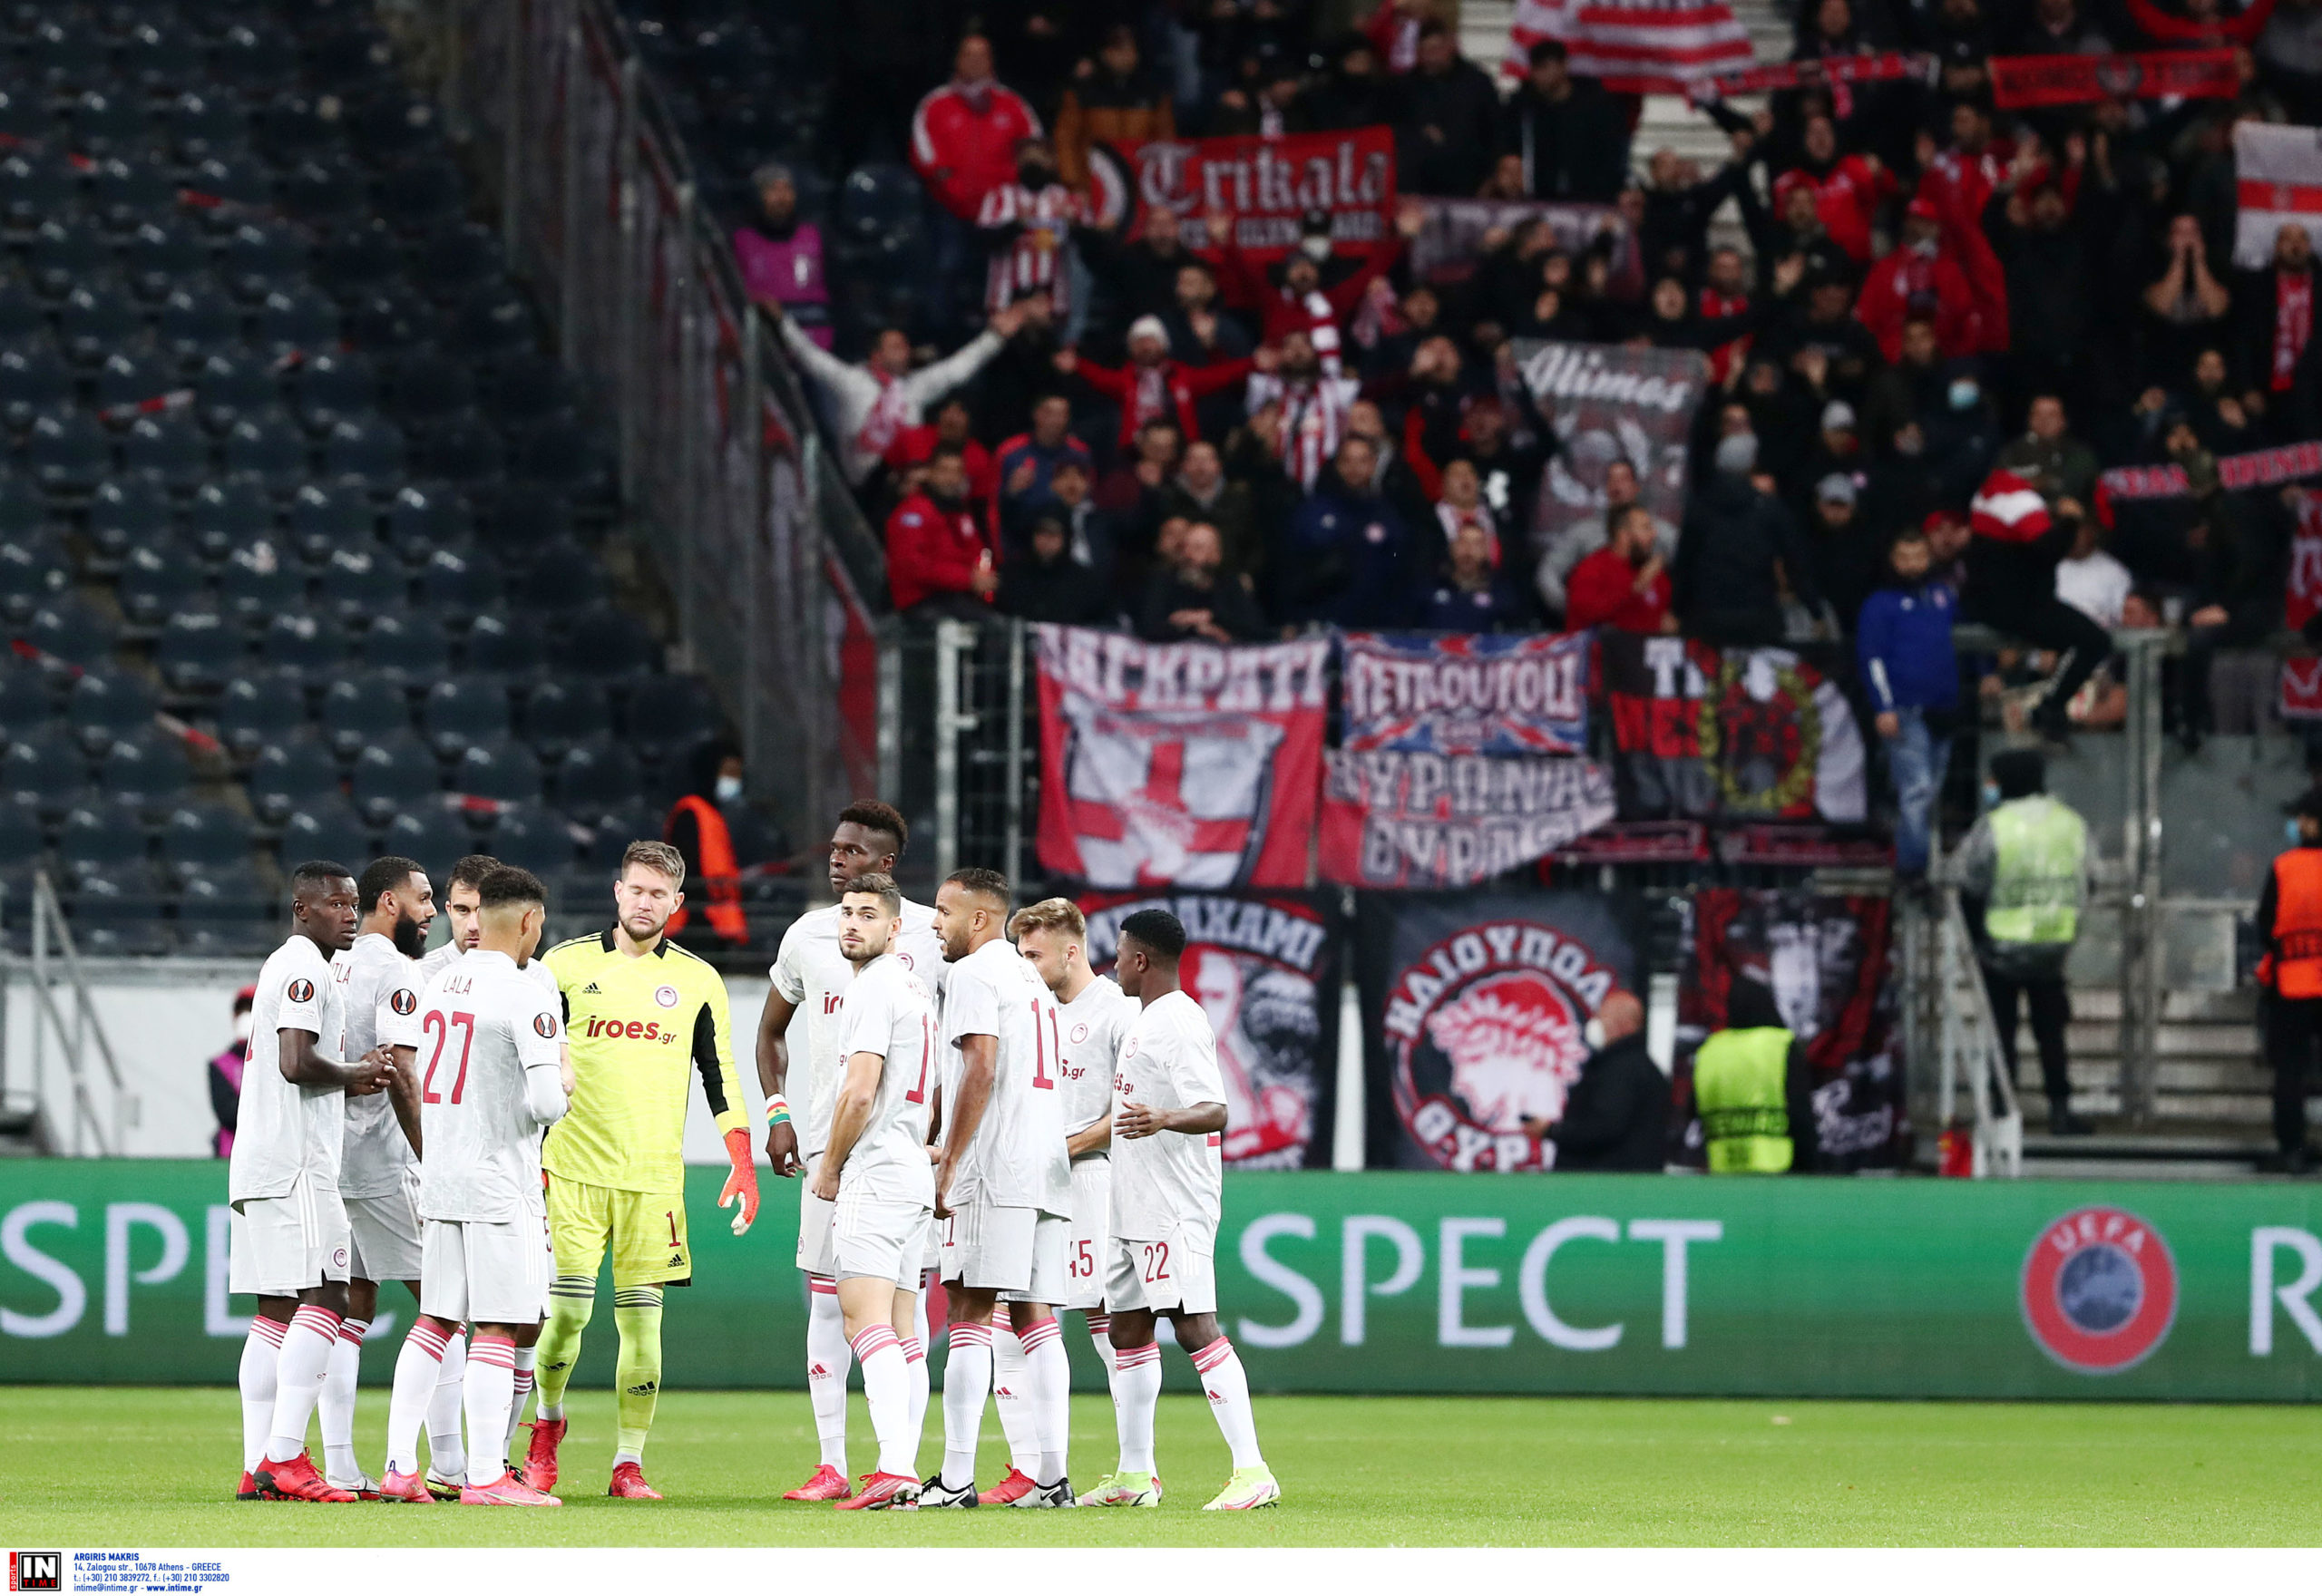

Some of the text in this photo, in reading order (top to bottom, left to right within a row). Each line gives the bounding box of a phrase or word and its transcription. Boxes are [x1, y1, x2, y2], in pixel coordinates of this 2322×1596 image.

[1137, 141, 1389, 214] Trikala
[443, 975, 473, 996] LALA
[1385, 923, 1612, 1040] ΗΛΙΟΥΠΟΛ
[586, 1015, 678, 1045] iroes.gr
[422, 1009, 475, 1105] 27
[666, 1211, 682, 1248] 1
[2051, 1212, 2146, 1254] UEFA
[1144, 1241, 1170, 1283] 22
[1217, 1212, 1723, 1352] SPECT
